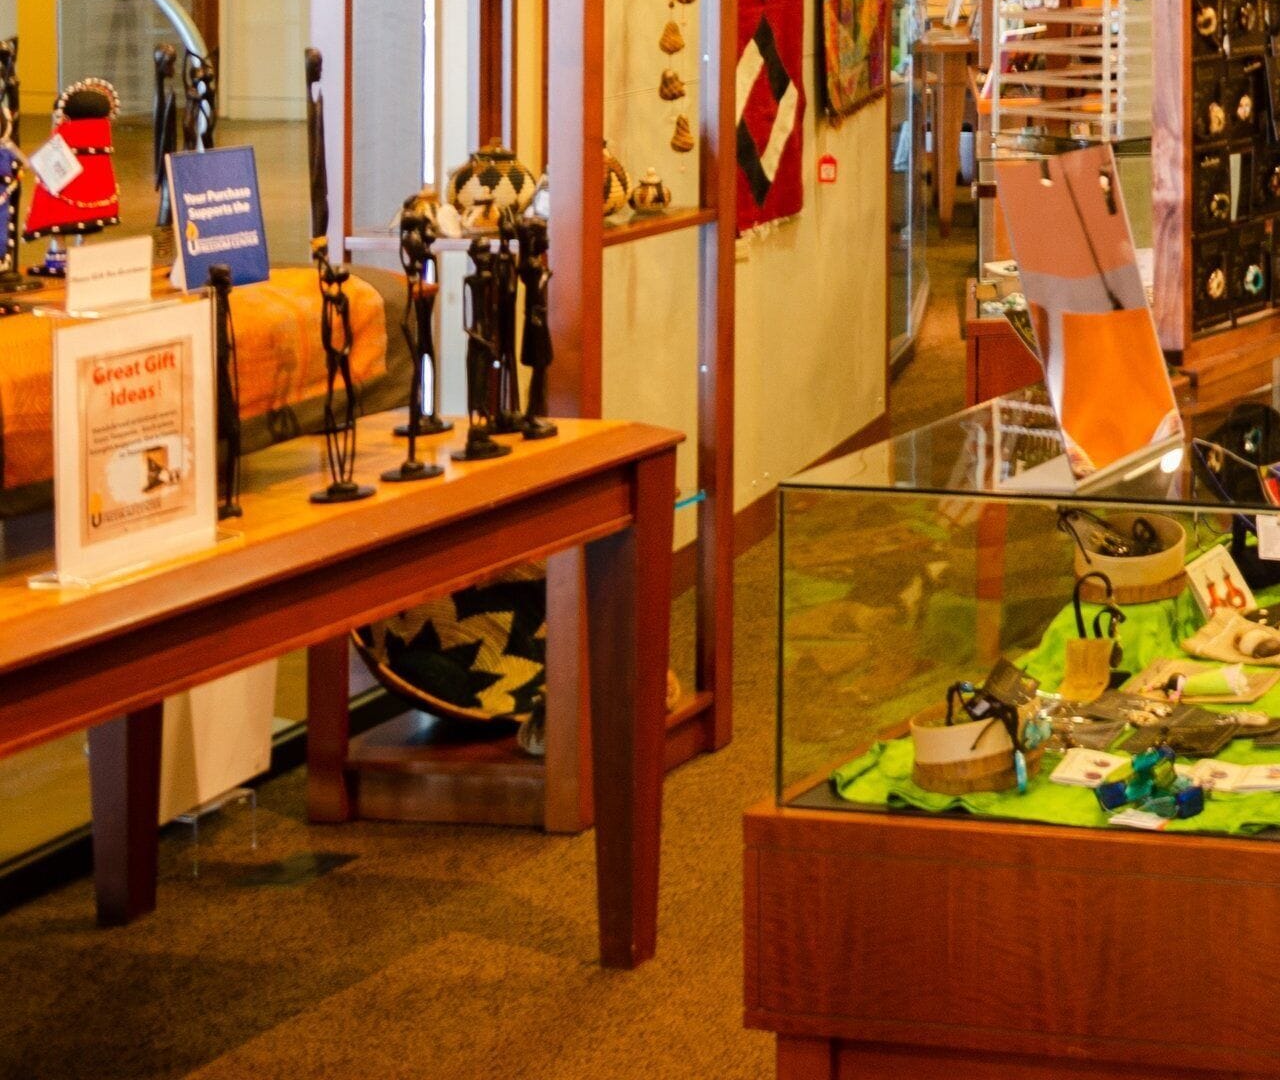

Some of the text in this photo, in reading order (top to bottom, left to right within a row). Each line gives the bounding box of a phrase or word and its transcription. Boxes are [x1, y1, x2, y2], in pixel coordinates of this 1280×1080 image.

[183, 187, 251, 206] Your Purchase
[188, 203, 232, 221] Supports
[92, 351, 176, 386] Great Gift
